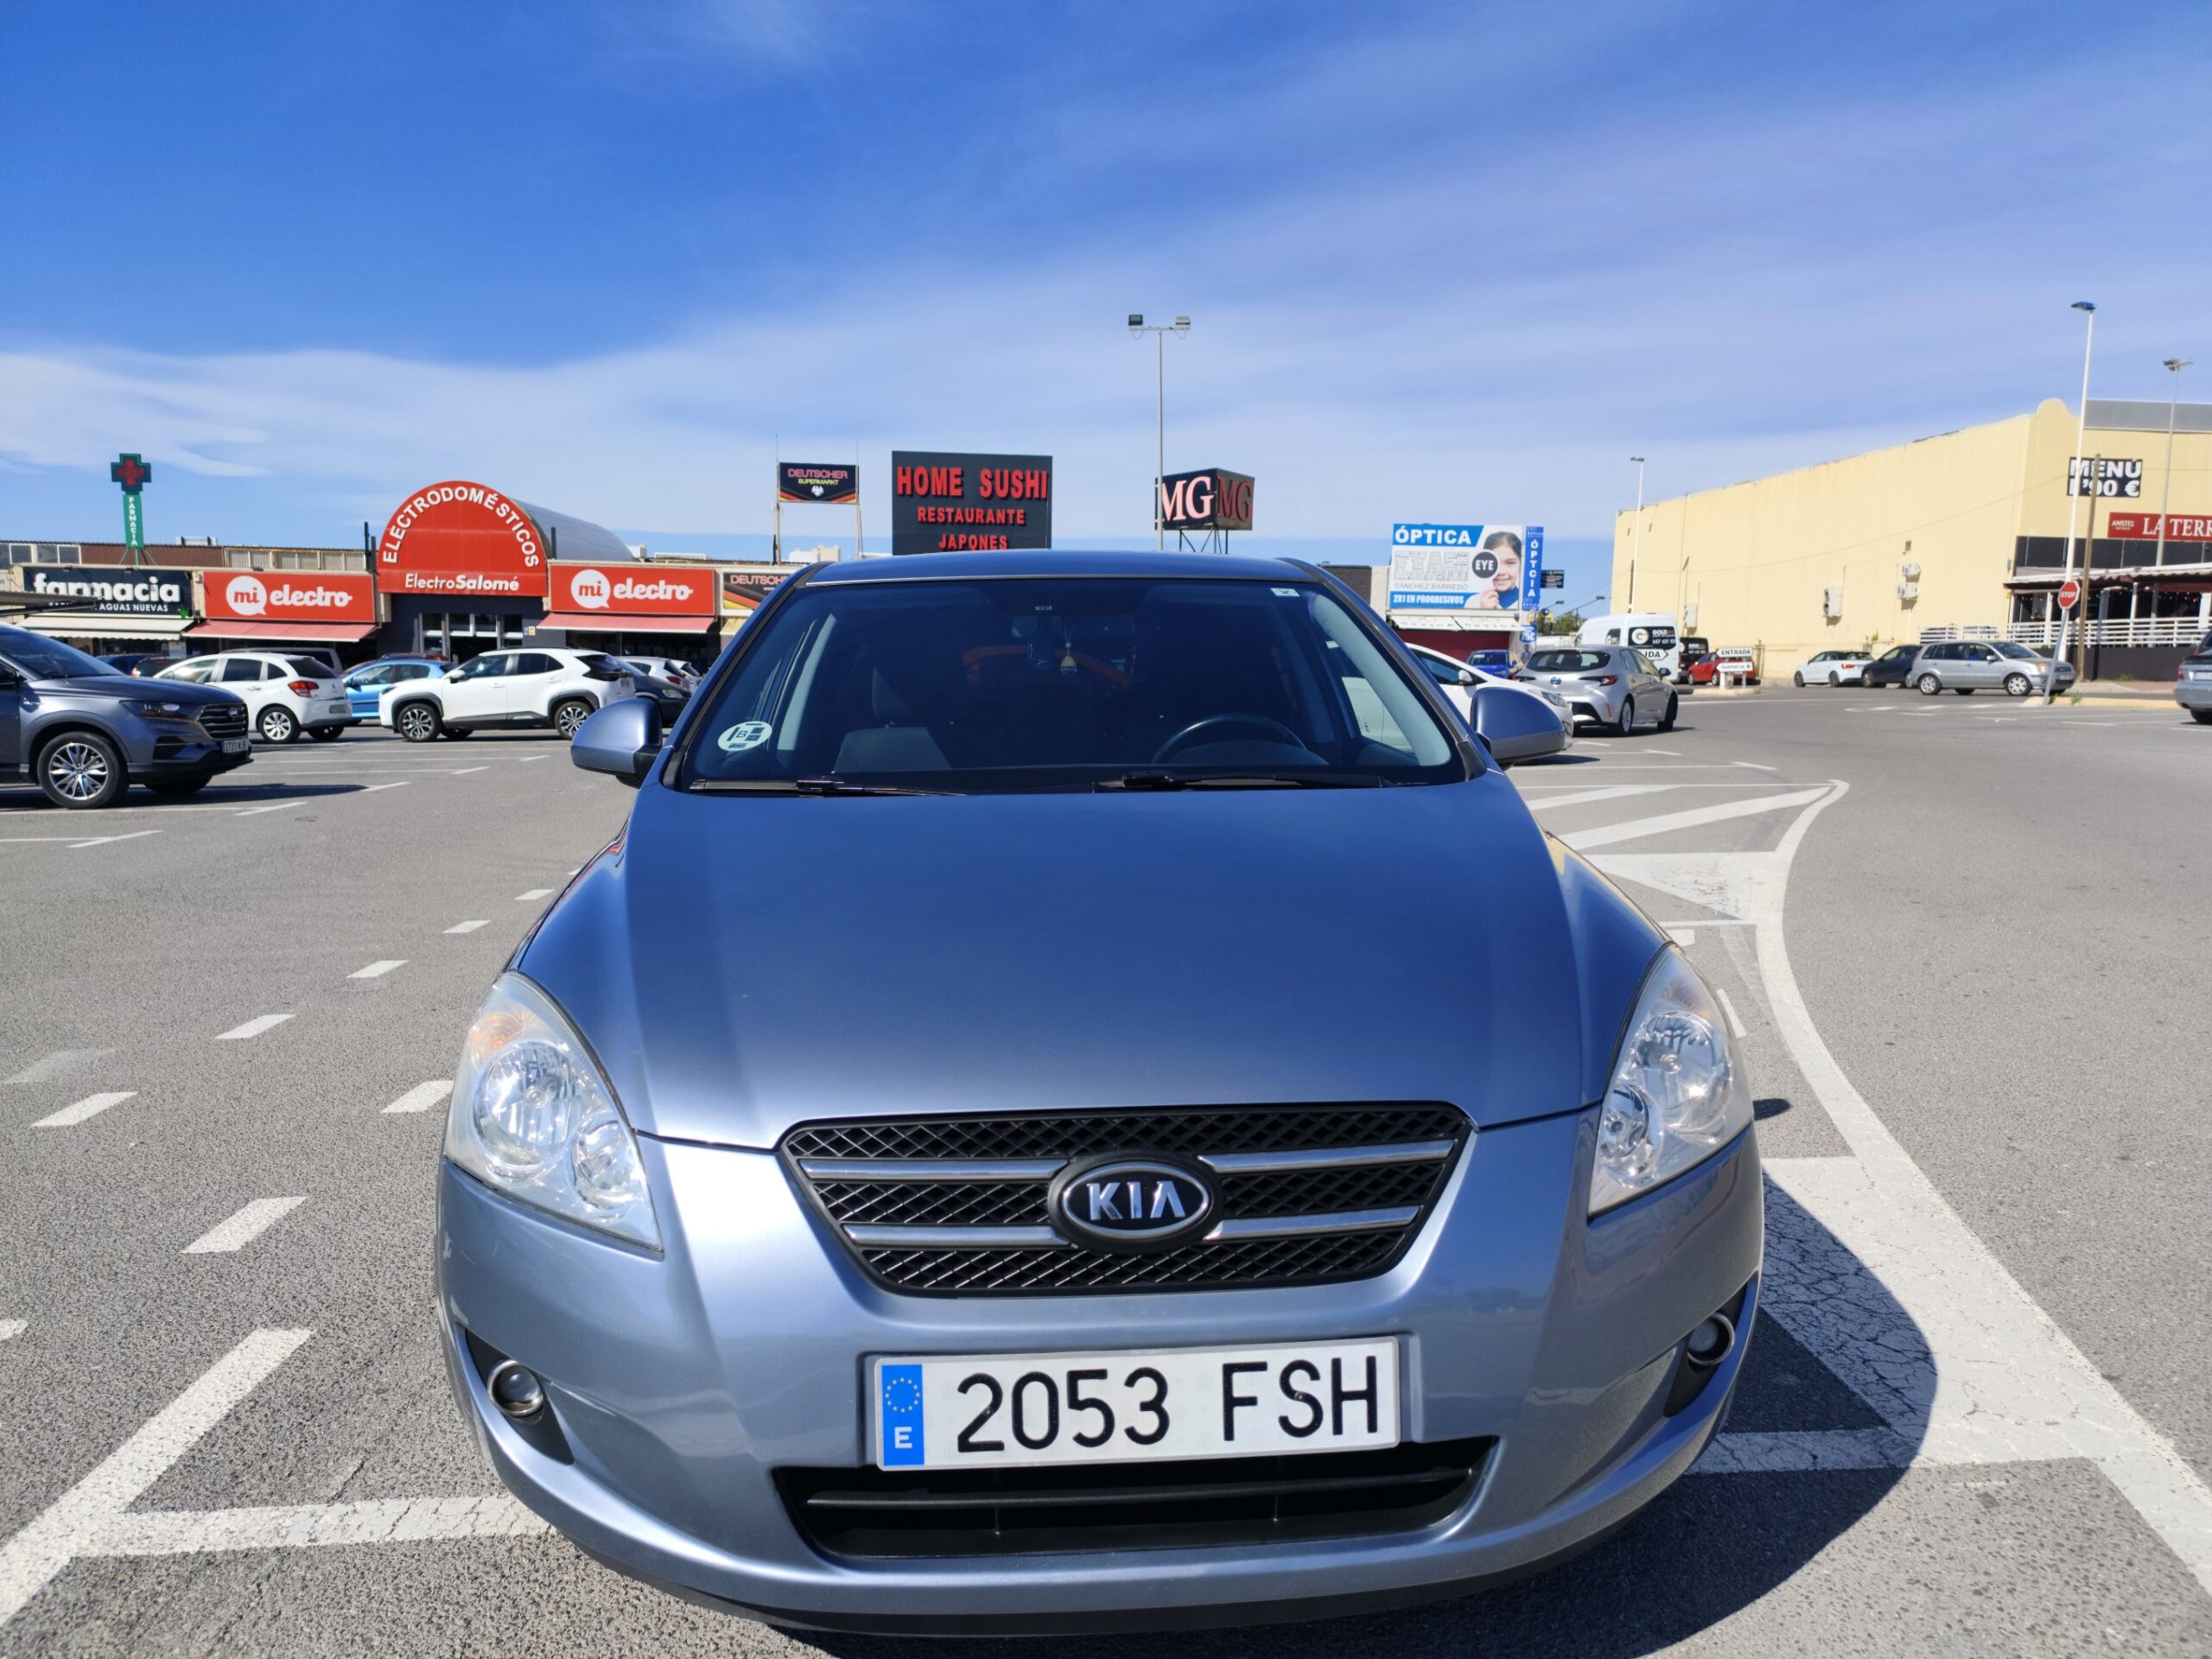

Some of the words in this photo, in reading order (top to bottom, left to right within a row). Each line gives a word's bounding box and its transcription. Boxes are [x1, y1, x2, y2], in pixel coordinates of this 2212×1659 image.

[788, 468, 848, 479] DEUTSCHER
[897, 467, 963, 496] HOME
[979, 469, 1049, 499] SUSHI
[1155, 476, 1214, 521] MG
[1217, 475, 1252, 522] MG
[2125, 480, 2139, 497] €
[129, 496, 138, 545] FARMACIA
[918, 506, 1026, 524] RESTAURANTE
[383, 486, 539, 567] ELECTRODOMÉSTICOS
[1395, 525, 1471, 544] ÓPTICA
[2170, 518, 2212, 537] TERR
[938, 533, 1008, 550] JAPONES
[1476, 560, 1494, 570] EYE
[34, 573, 181, 602] farmacia
[405, 573, 519, 591] ElectroSalomé
[578, 581, 604, 597] mi
[613, 577, 694, 601] electro
[730, 575, 788, 585] DEUTSCH
[233, 588, 260, 603] mi
[270, 584, 353, 607] electro
[1416, 595, 1464, 604] PROGRESIVOS
[99, 603, 130, 612] AGUAS
[1086, 1180, 1187, 1221] KIA
[957, 1367, 1170, 1452] 2053
[1223, 1357, 1377, 1441] FSH
[894, 1427, 912, 1449] E
